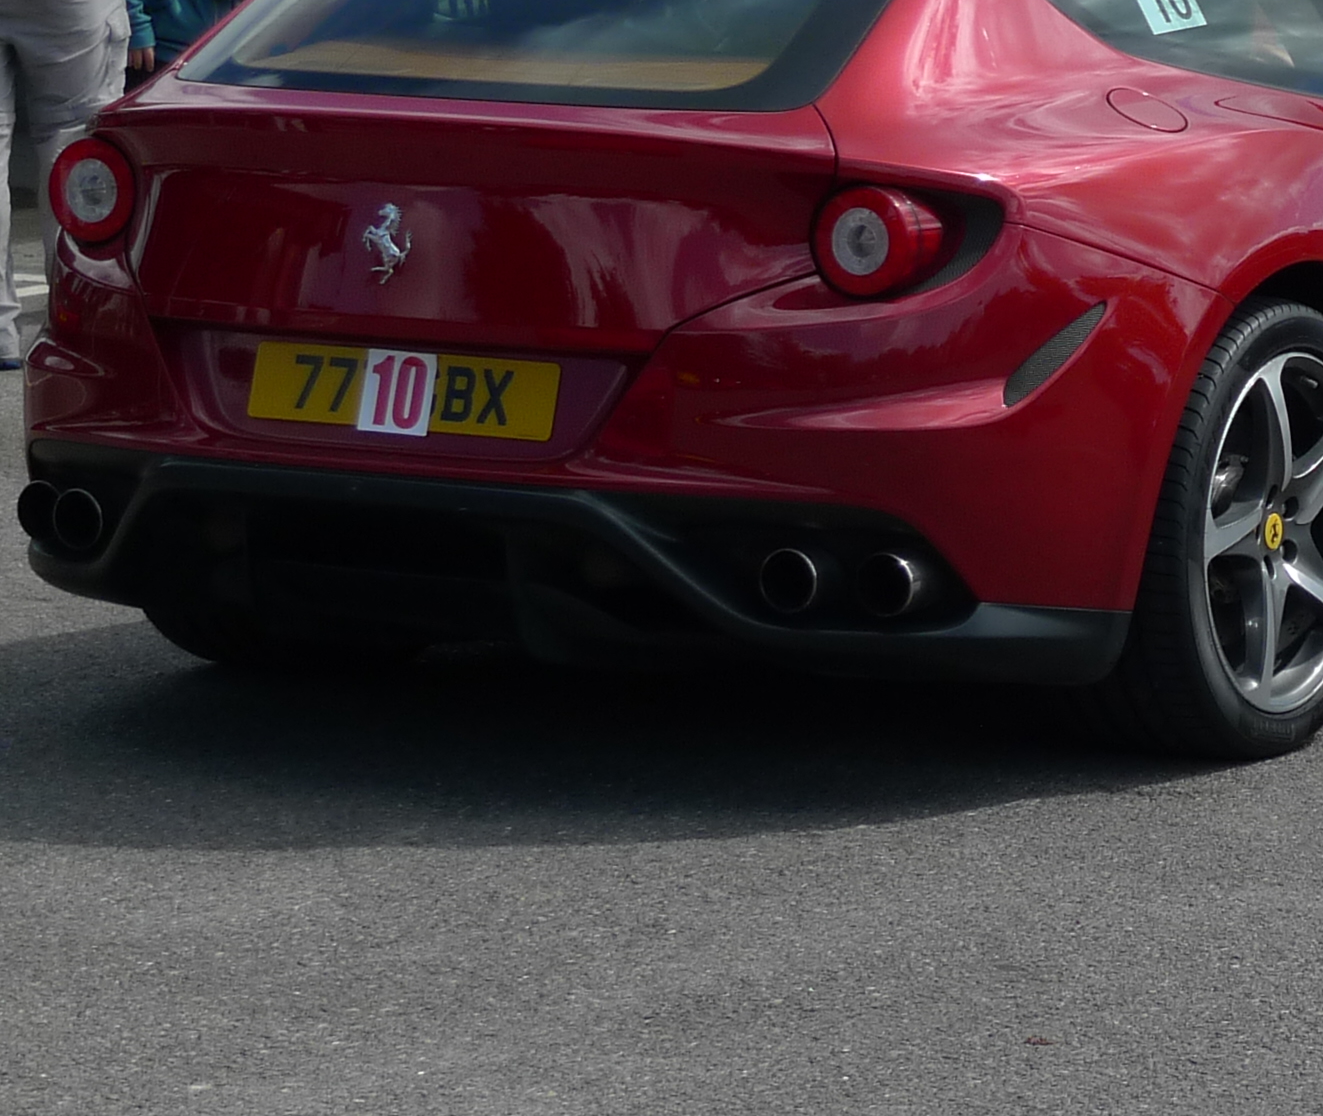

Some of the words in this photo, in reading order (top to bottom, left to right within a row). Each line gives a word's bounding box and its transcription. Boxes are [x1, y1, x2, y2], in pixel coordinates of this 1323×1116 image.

[295, 353, 366, 413] 77
[431, 365, 514, 427] BX
[371, 355, 429, 430] 10
